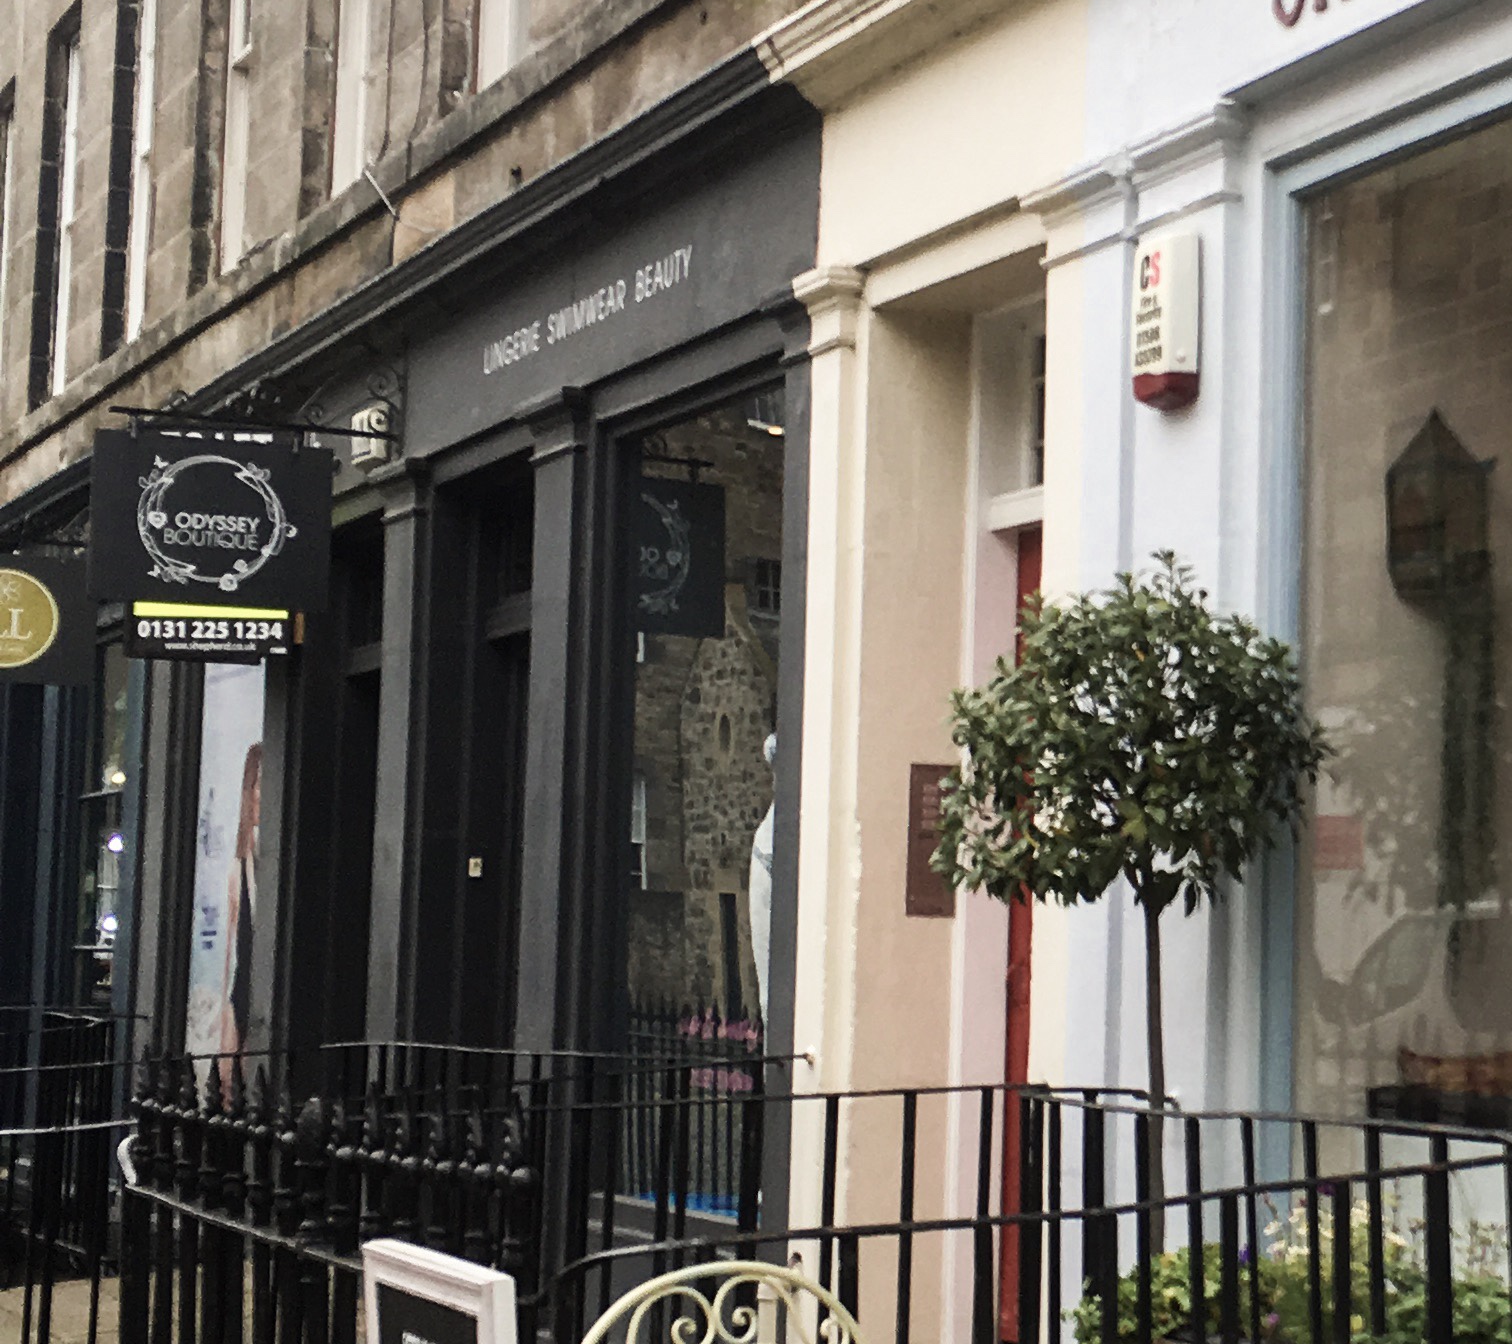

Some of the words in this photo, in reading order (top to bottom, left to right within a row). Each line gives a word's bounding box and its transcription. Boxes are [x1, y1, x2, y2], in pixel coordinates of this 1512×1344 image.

[1139, 251, 1161, 290] CS
[483, 320, 541, 375] LINGERIE
[547, 279, 626, 345] SWIMWEAR
[635, 244, 693, 303] BEAUTY
[175, 511, 260, 533] ODYSSEY
[163, 527, 259, 551] BOUTIQUE
[137, 619, 187, 638] 0131
[191, 620, 230, 639] 225
[234, 621, 283, 640] 1234
